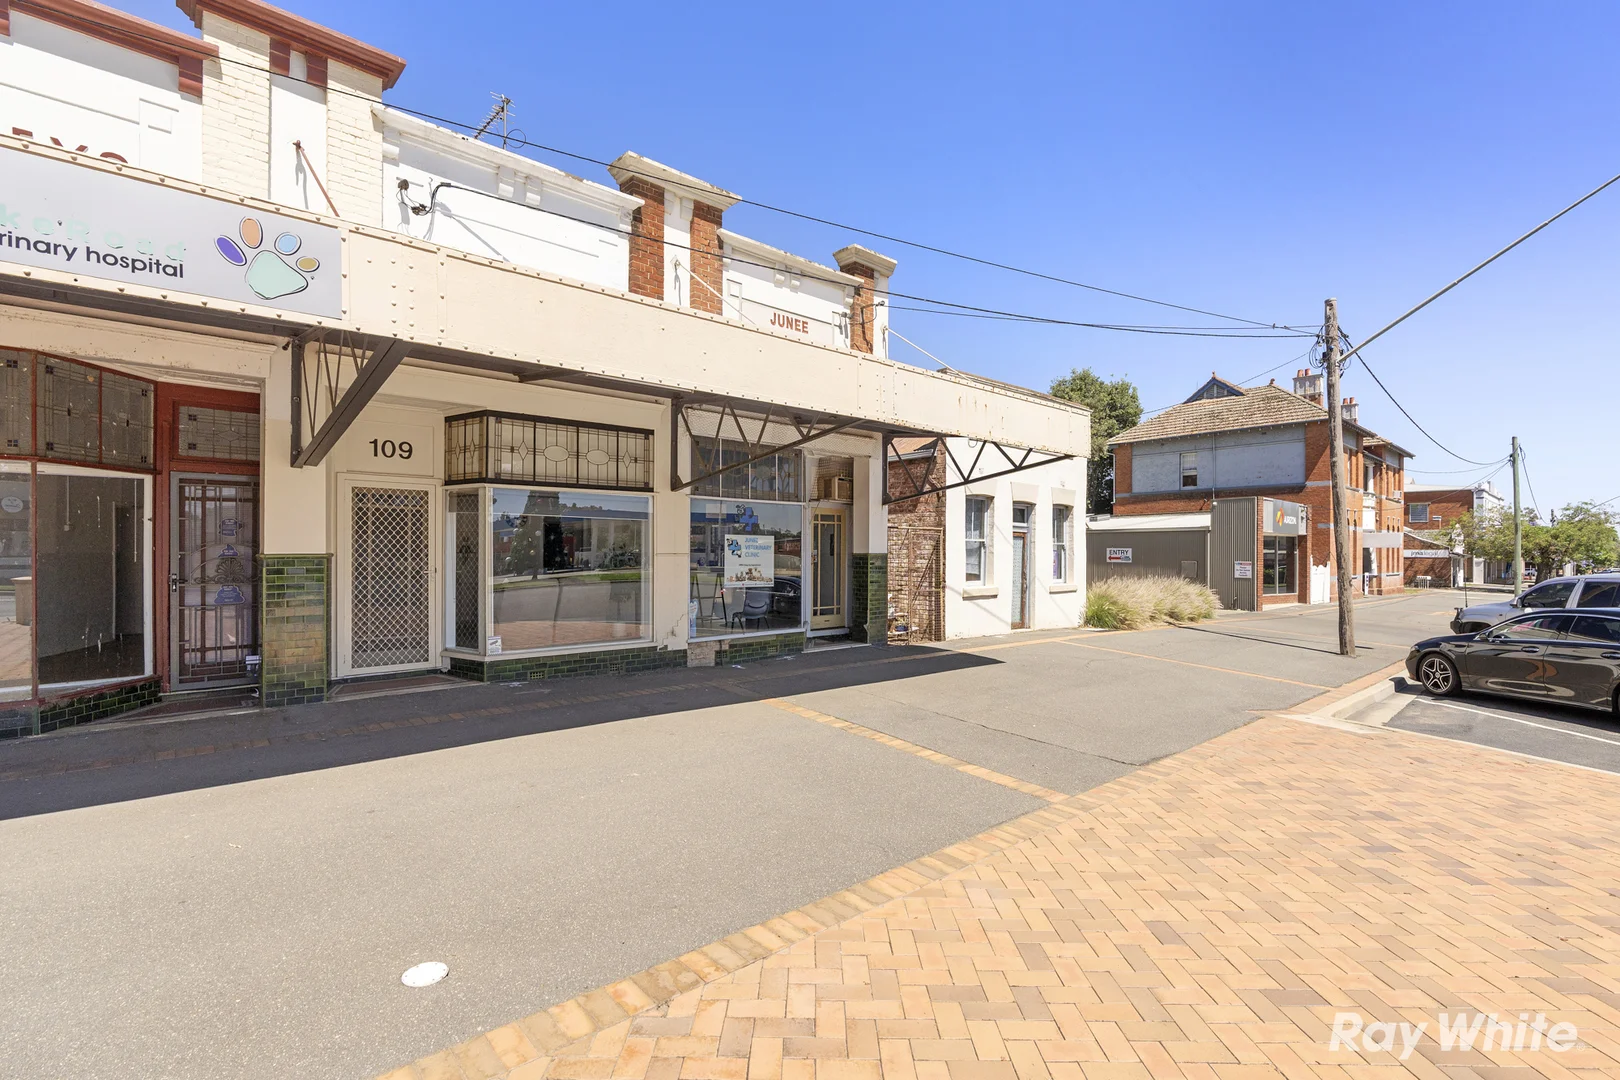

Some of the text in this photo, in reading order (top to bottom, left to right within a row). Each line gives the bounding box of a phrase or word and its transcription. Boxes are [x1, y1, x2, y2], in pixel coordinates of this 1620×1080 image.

[86, 246, 184, 279] hospital
[770, 312, 809, 334] JUNEE
[369, 438, 413, 460] 109
